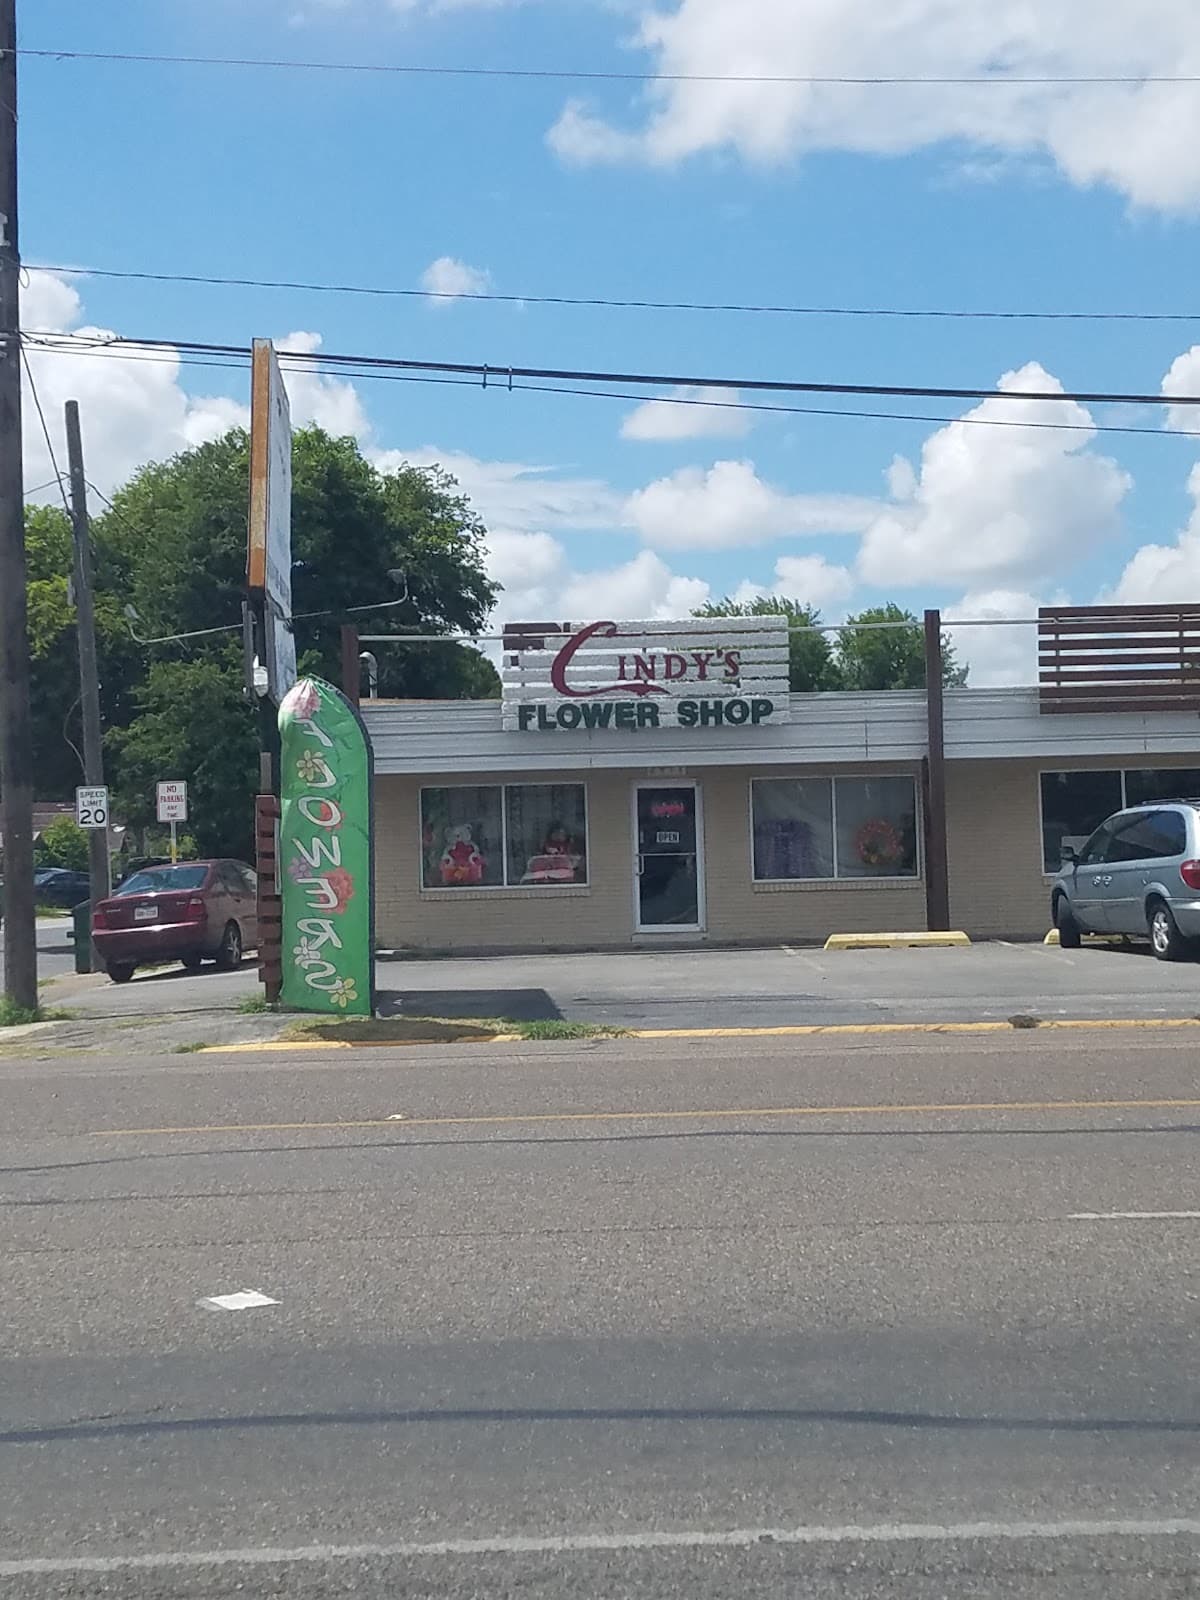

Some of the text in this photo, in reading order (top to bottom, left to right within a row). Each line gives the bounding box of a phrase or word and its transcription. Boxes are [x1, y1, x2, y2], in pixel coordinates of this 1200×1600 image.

[551, 621, 741, 697] CINDY'S
[518, 698, 774, 730] FLOWER SHOP
[166, 785, 176, 793] NO
[82, 799, 102, 807] LIMIT
[80, 809, 106, 824] 20
[658, 833, 678, 842] OPEN
